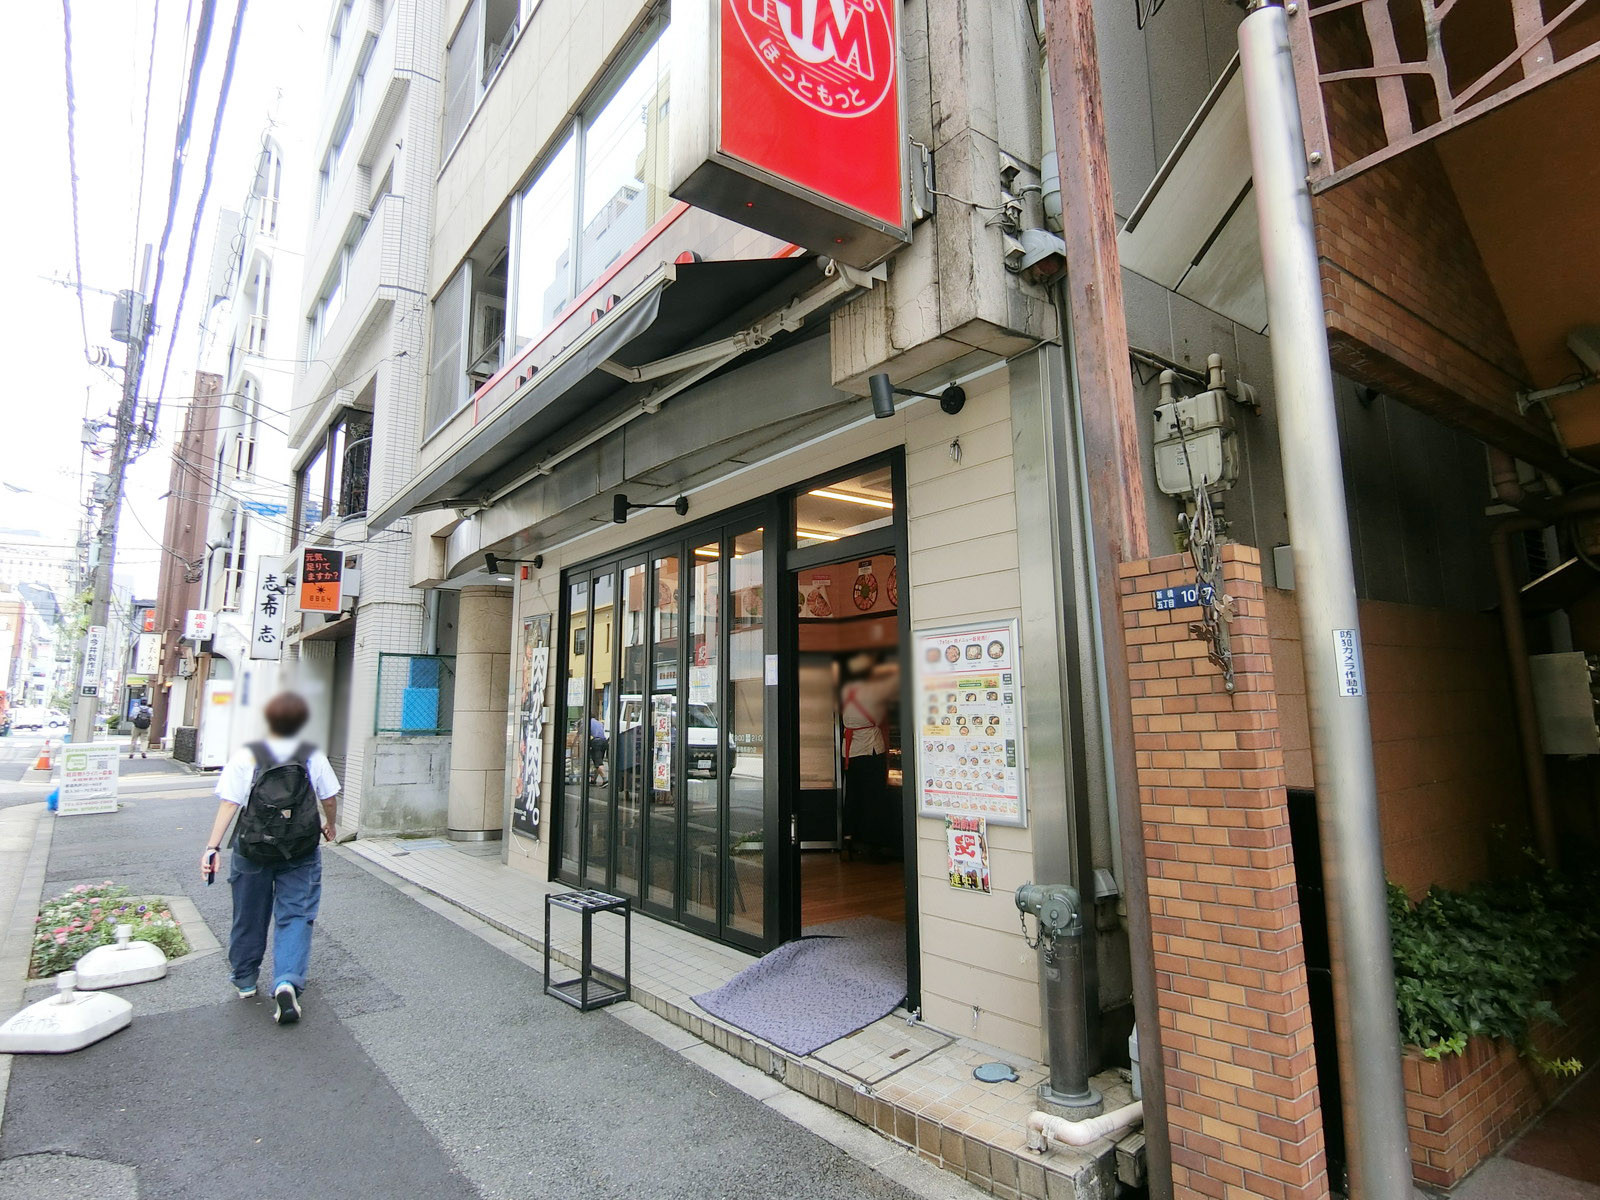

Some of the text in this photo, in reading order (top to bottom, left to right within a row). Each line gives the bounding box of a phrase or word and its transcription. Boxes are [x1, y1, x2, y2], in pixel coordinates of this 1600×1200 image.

[758, 37, 866, 109] ほっともっと
[306, 562, 331, 571] 足りて
[1157, 599, 1175, 609] 五丁目
[1340, 630, 1358, 696] 防犯カメラ作動中
